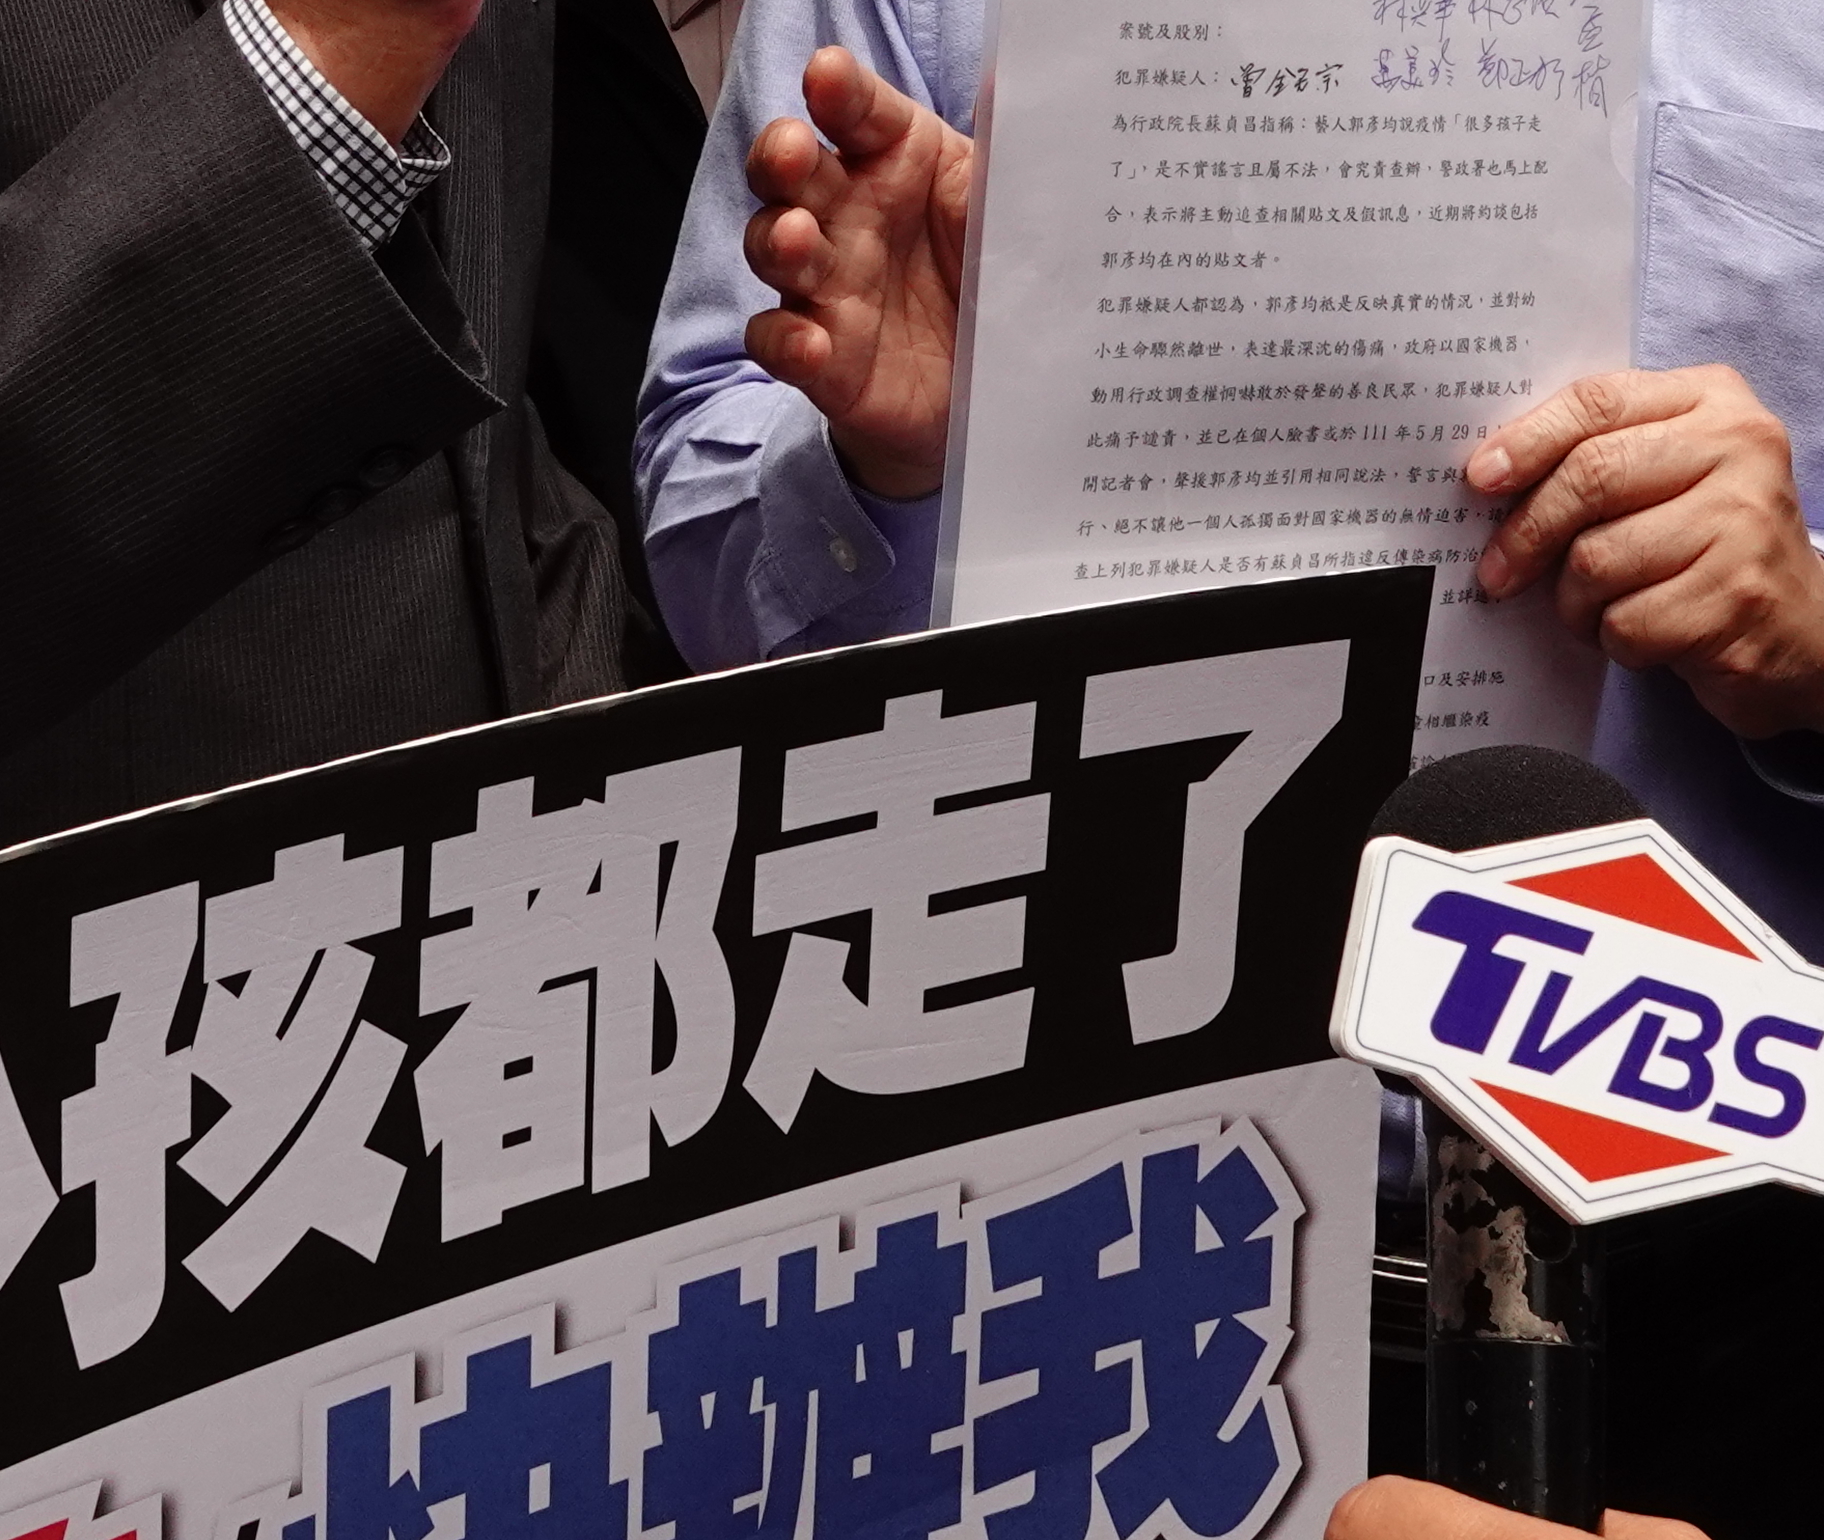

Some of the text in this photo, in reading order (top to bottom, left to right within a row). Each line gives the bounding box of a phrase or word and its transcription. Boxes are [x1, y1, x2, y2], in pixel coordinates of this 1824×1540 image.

[1118, 21, 1223, 41] 案號及股別：
[1082, 466, 1468, 493] 開記者會，聲援郭彥均並引用相同說法，誓言與
[1073, 547, 1485, 580] 查上列犯罪嫌疑人是否有蘇貞昌所指違反傳染病防治
